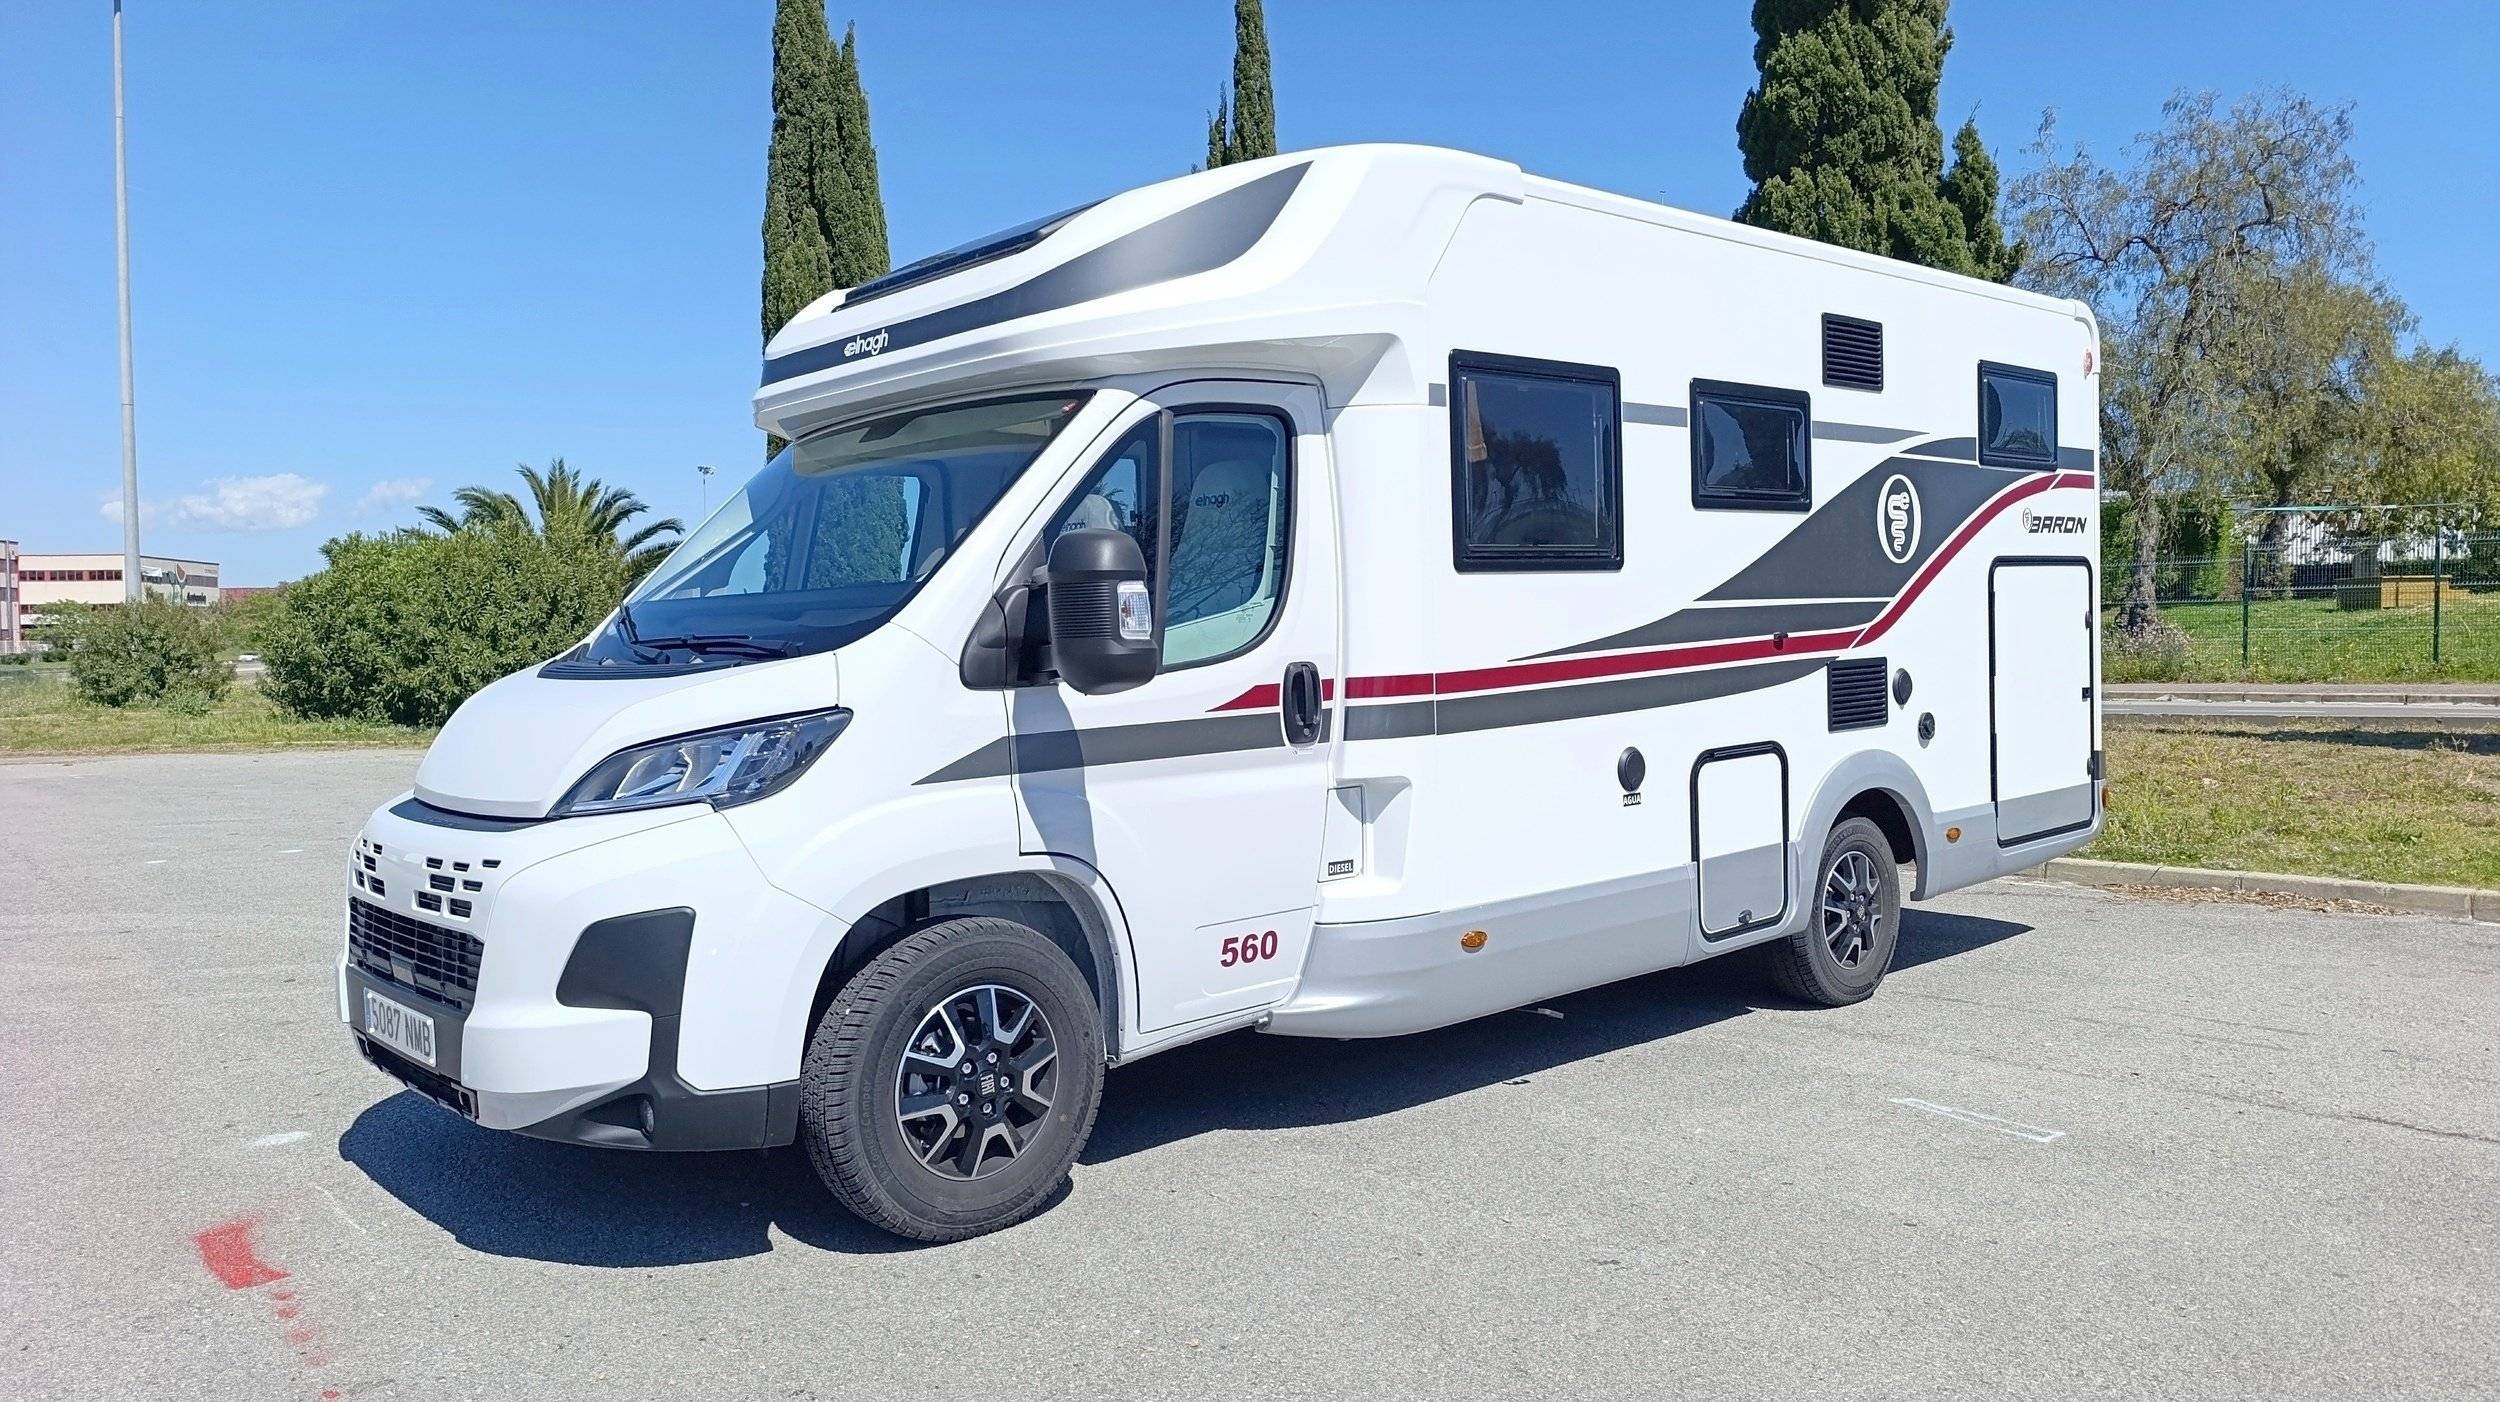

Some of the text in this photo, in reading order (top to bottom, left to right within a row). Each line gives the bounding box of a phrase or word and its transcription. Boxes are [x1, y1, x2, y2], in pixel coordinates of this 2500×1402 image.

[844, 329, 888, 357] elnagh
[1195, 490, 1229, 508] elnagh
[2029, 516, 2087, 534] BARON
[1623, 794, 1641, 806] AGUA
[1329, 862, 1354, 875] DIESEL
[1220, 930, 1278, 967] 560
[372, 998, 432, 1057] 5087 NMB
[980, 1073, 995, 1095] FIAT
